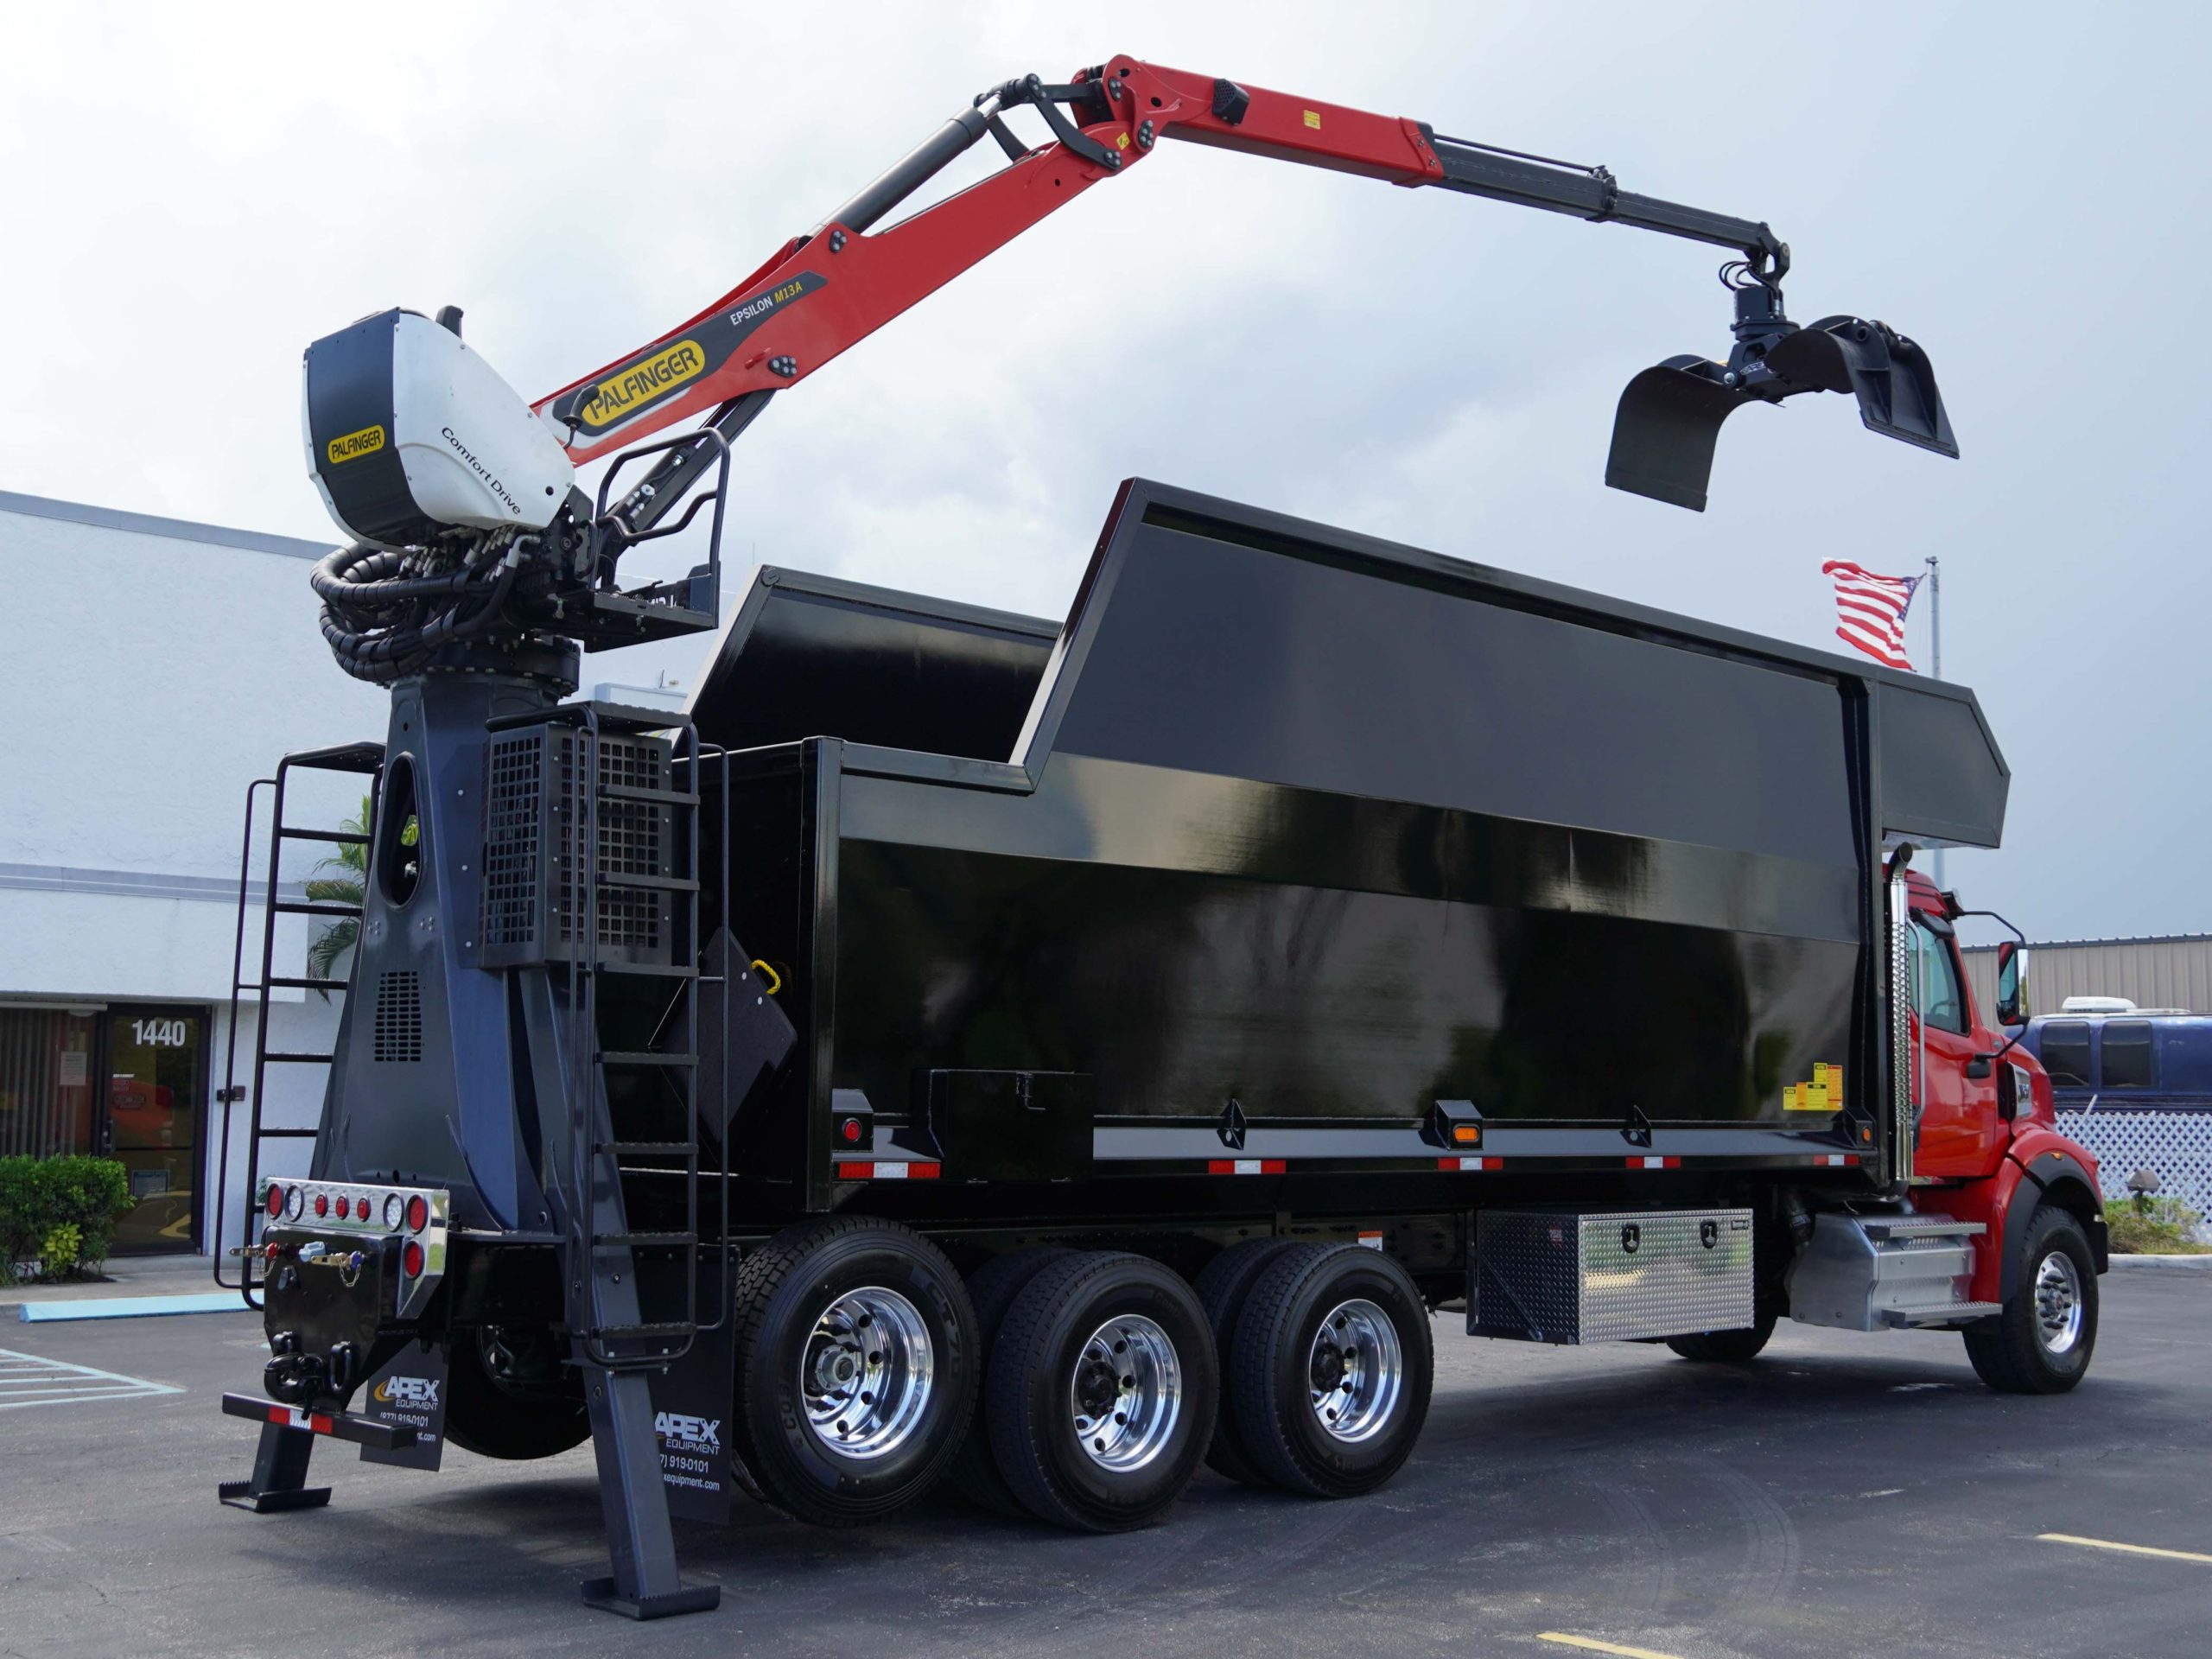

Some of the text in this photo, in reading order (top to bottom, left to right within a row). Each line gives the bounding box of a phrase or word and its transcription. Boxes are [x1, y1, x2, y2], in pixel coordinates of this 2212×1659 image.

[729, 281, 803, 326] EPSILON M13A
[588, 346, 699, 420] PALFINGER
[332, 429, 382, 459] PALFINGER
[442, 427, 521, 515] Comfort Drive
[131, 1019, 186, 1046] 1440
[384, 1376, 440, 1402] APEX
[396, 1399, 438, 1411] EQUIPMENT
[654, 1411, 721, 1445] APEX
[665, 1438, 721, 1455] EQUIPMENT
[670, 1455, 709, 1473] 919-0101
[663, 1473, 720, 1491] xequipment.com
